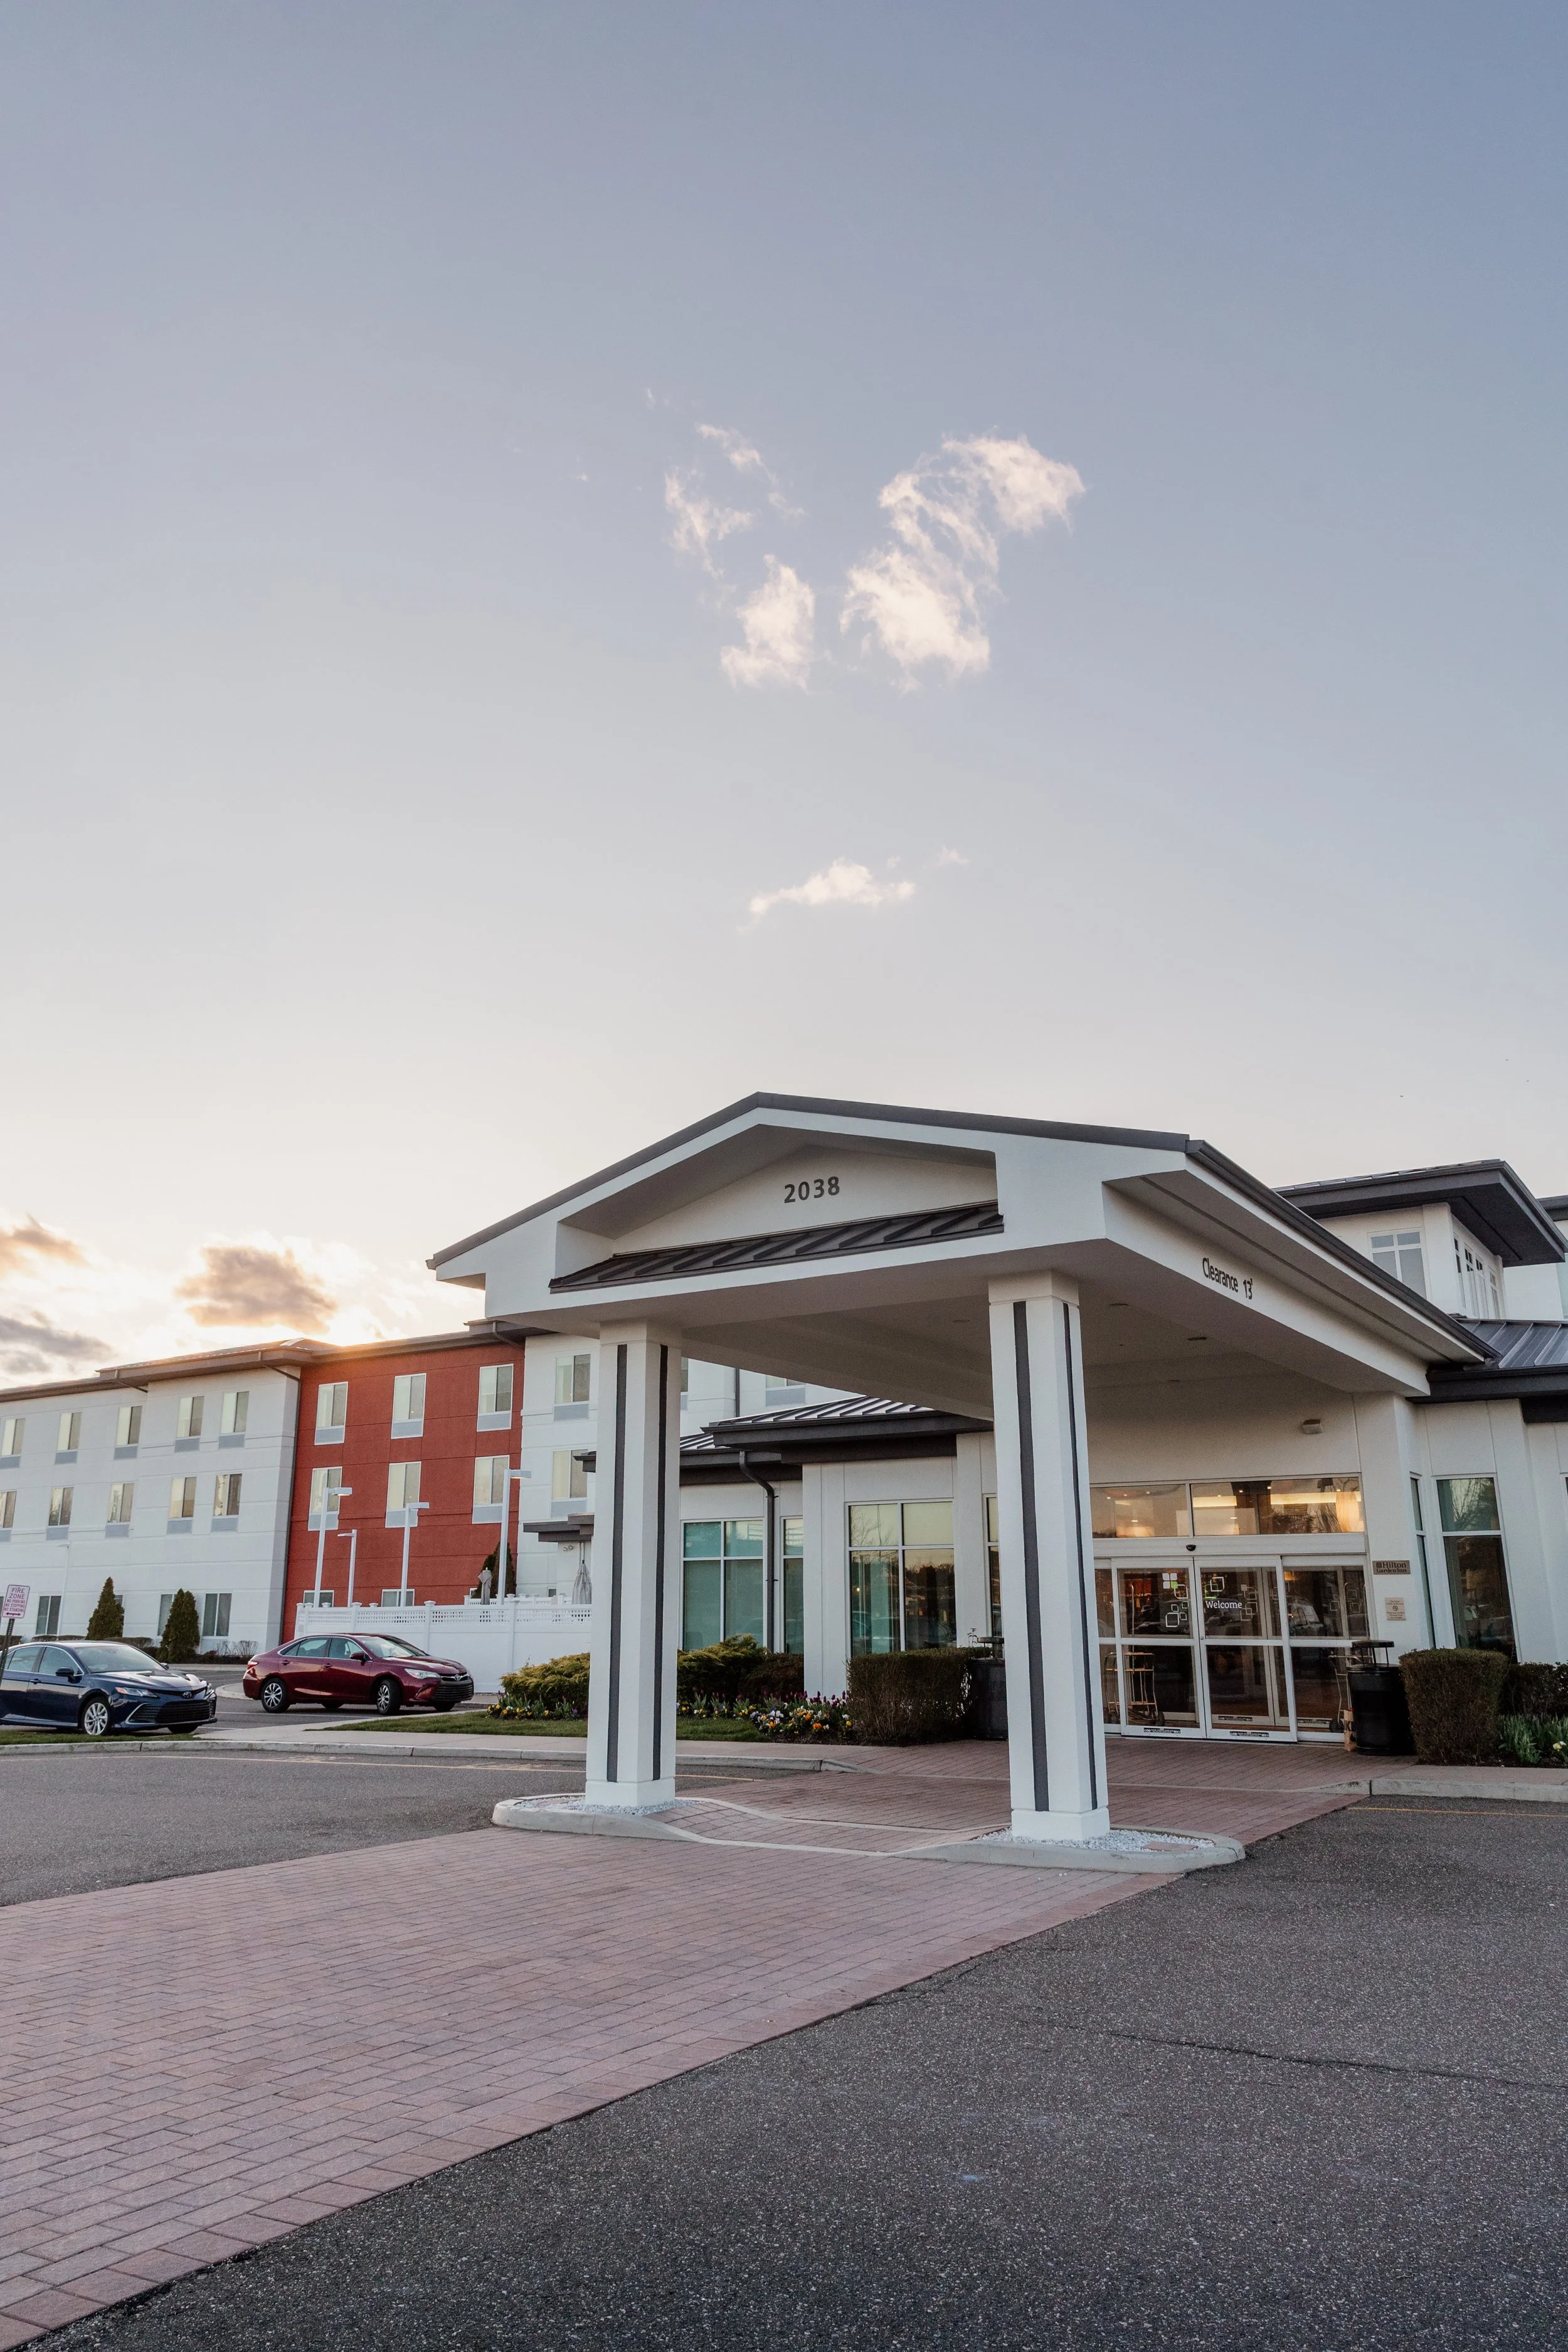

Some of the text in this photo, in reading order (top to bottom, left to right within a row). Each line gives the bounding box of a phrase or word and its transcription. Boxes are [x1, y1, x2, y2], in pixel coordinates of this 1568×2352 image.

[784, 1176, 840, 1204] 2038
[1202, 1258, 1253, 1300] Clearance 13'
[1205, 1600, 1242, 1609] Welcome
